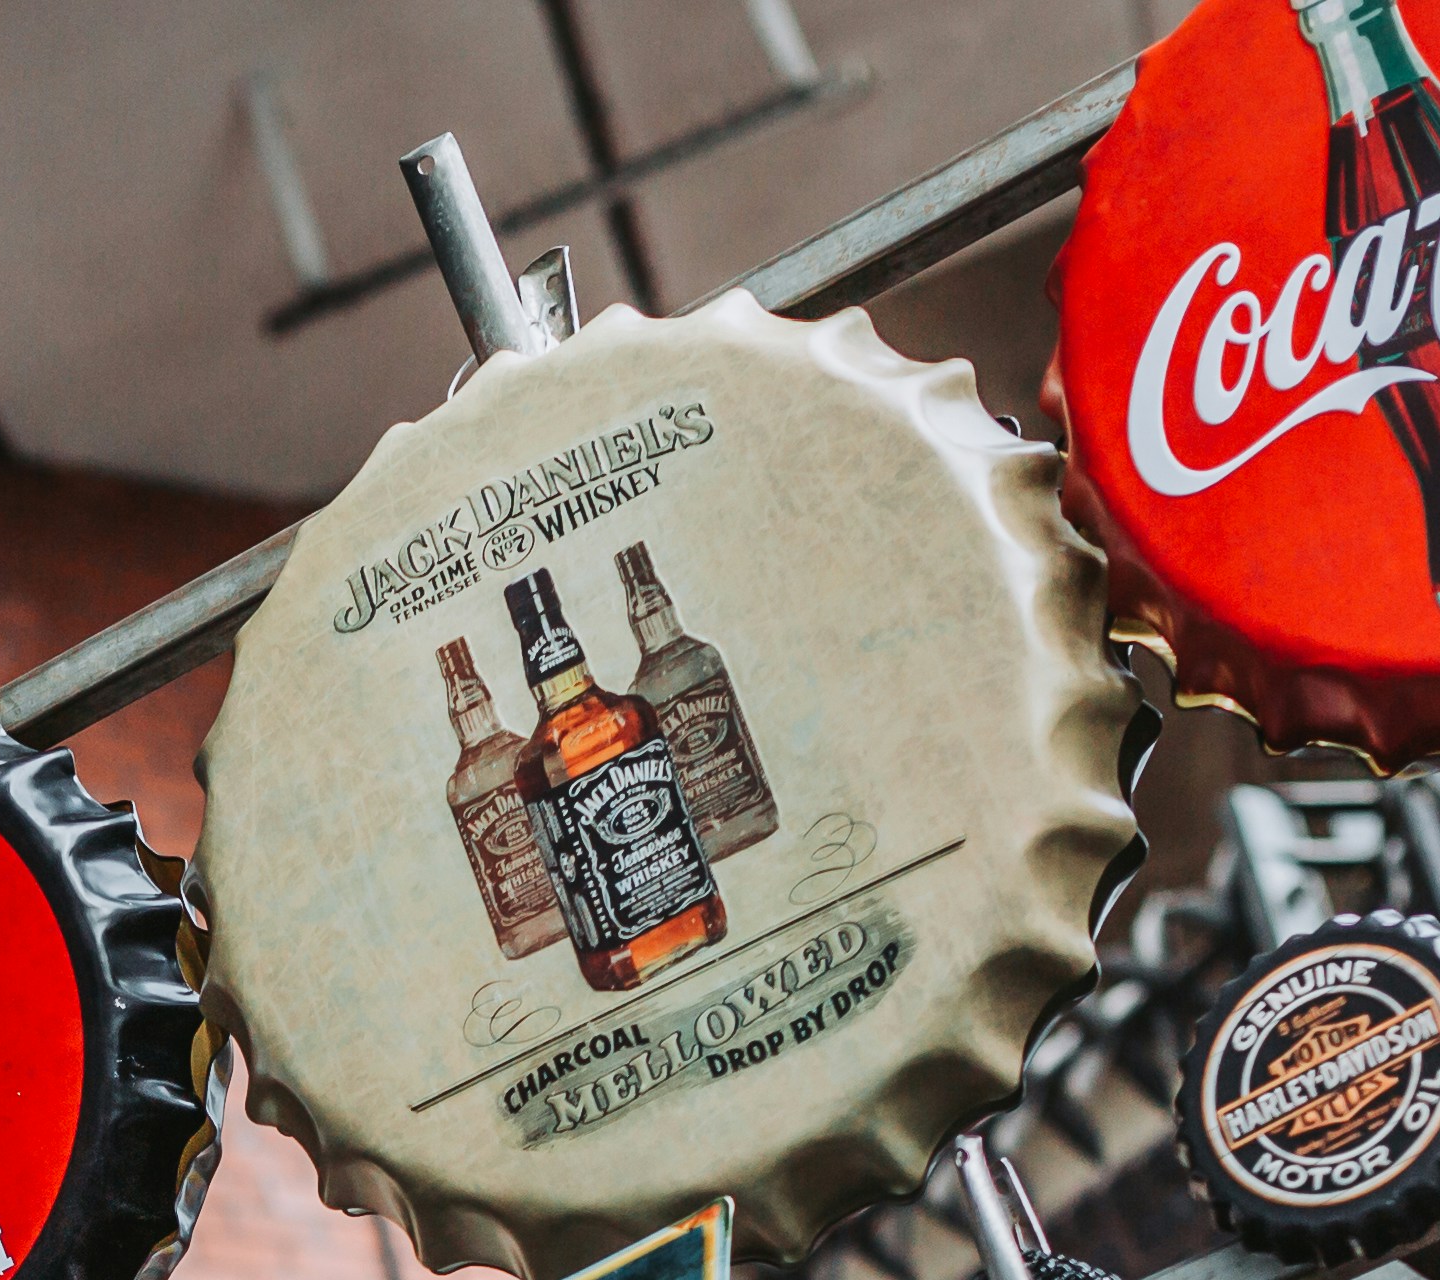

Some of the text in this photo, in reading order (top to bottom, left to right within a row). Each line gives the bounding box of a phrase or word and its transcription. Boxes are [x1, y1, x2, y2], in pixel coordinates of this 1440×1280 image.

[333, 402, 715, 634] JACK DANIEL'S
[491, 526, 519, 546] OLD
[533, 463, 662, 543] WHISKEY
[389, 551, 477, 614] OLD TIME
[392, 572, 482, 624] TENNESSEE
[574, 779, 614, 826] JACK
[609, 755, 672, 794] DANIEL'S
[611, 826, 683, 873] Tennessee
[615, 844, 691, 895] WHISKEY
[546, 921, 867, 1133] MELLOWED
[707, 941, 900, 1079] DROP BY DROP
[1232, 960, 1377, 1052] GENUINE
[503, 1024, 650, 1115] CHARCOAL
[1224, 1008, 1440, 1140] HARLEY-DAVIDSON
[1282, 1022, 1361, 1070] MOTOR
[1252, 1144, 1392, 1191] MOTOR
